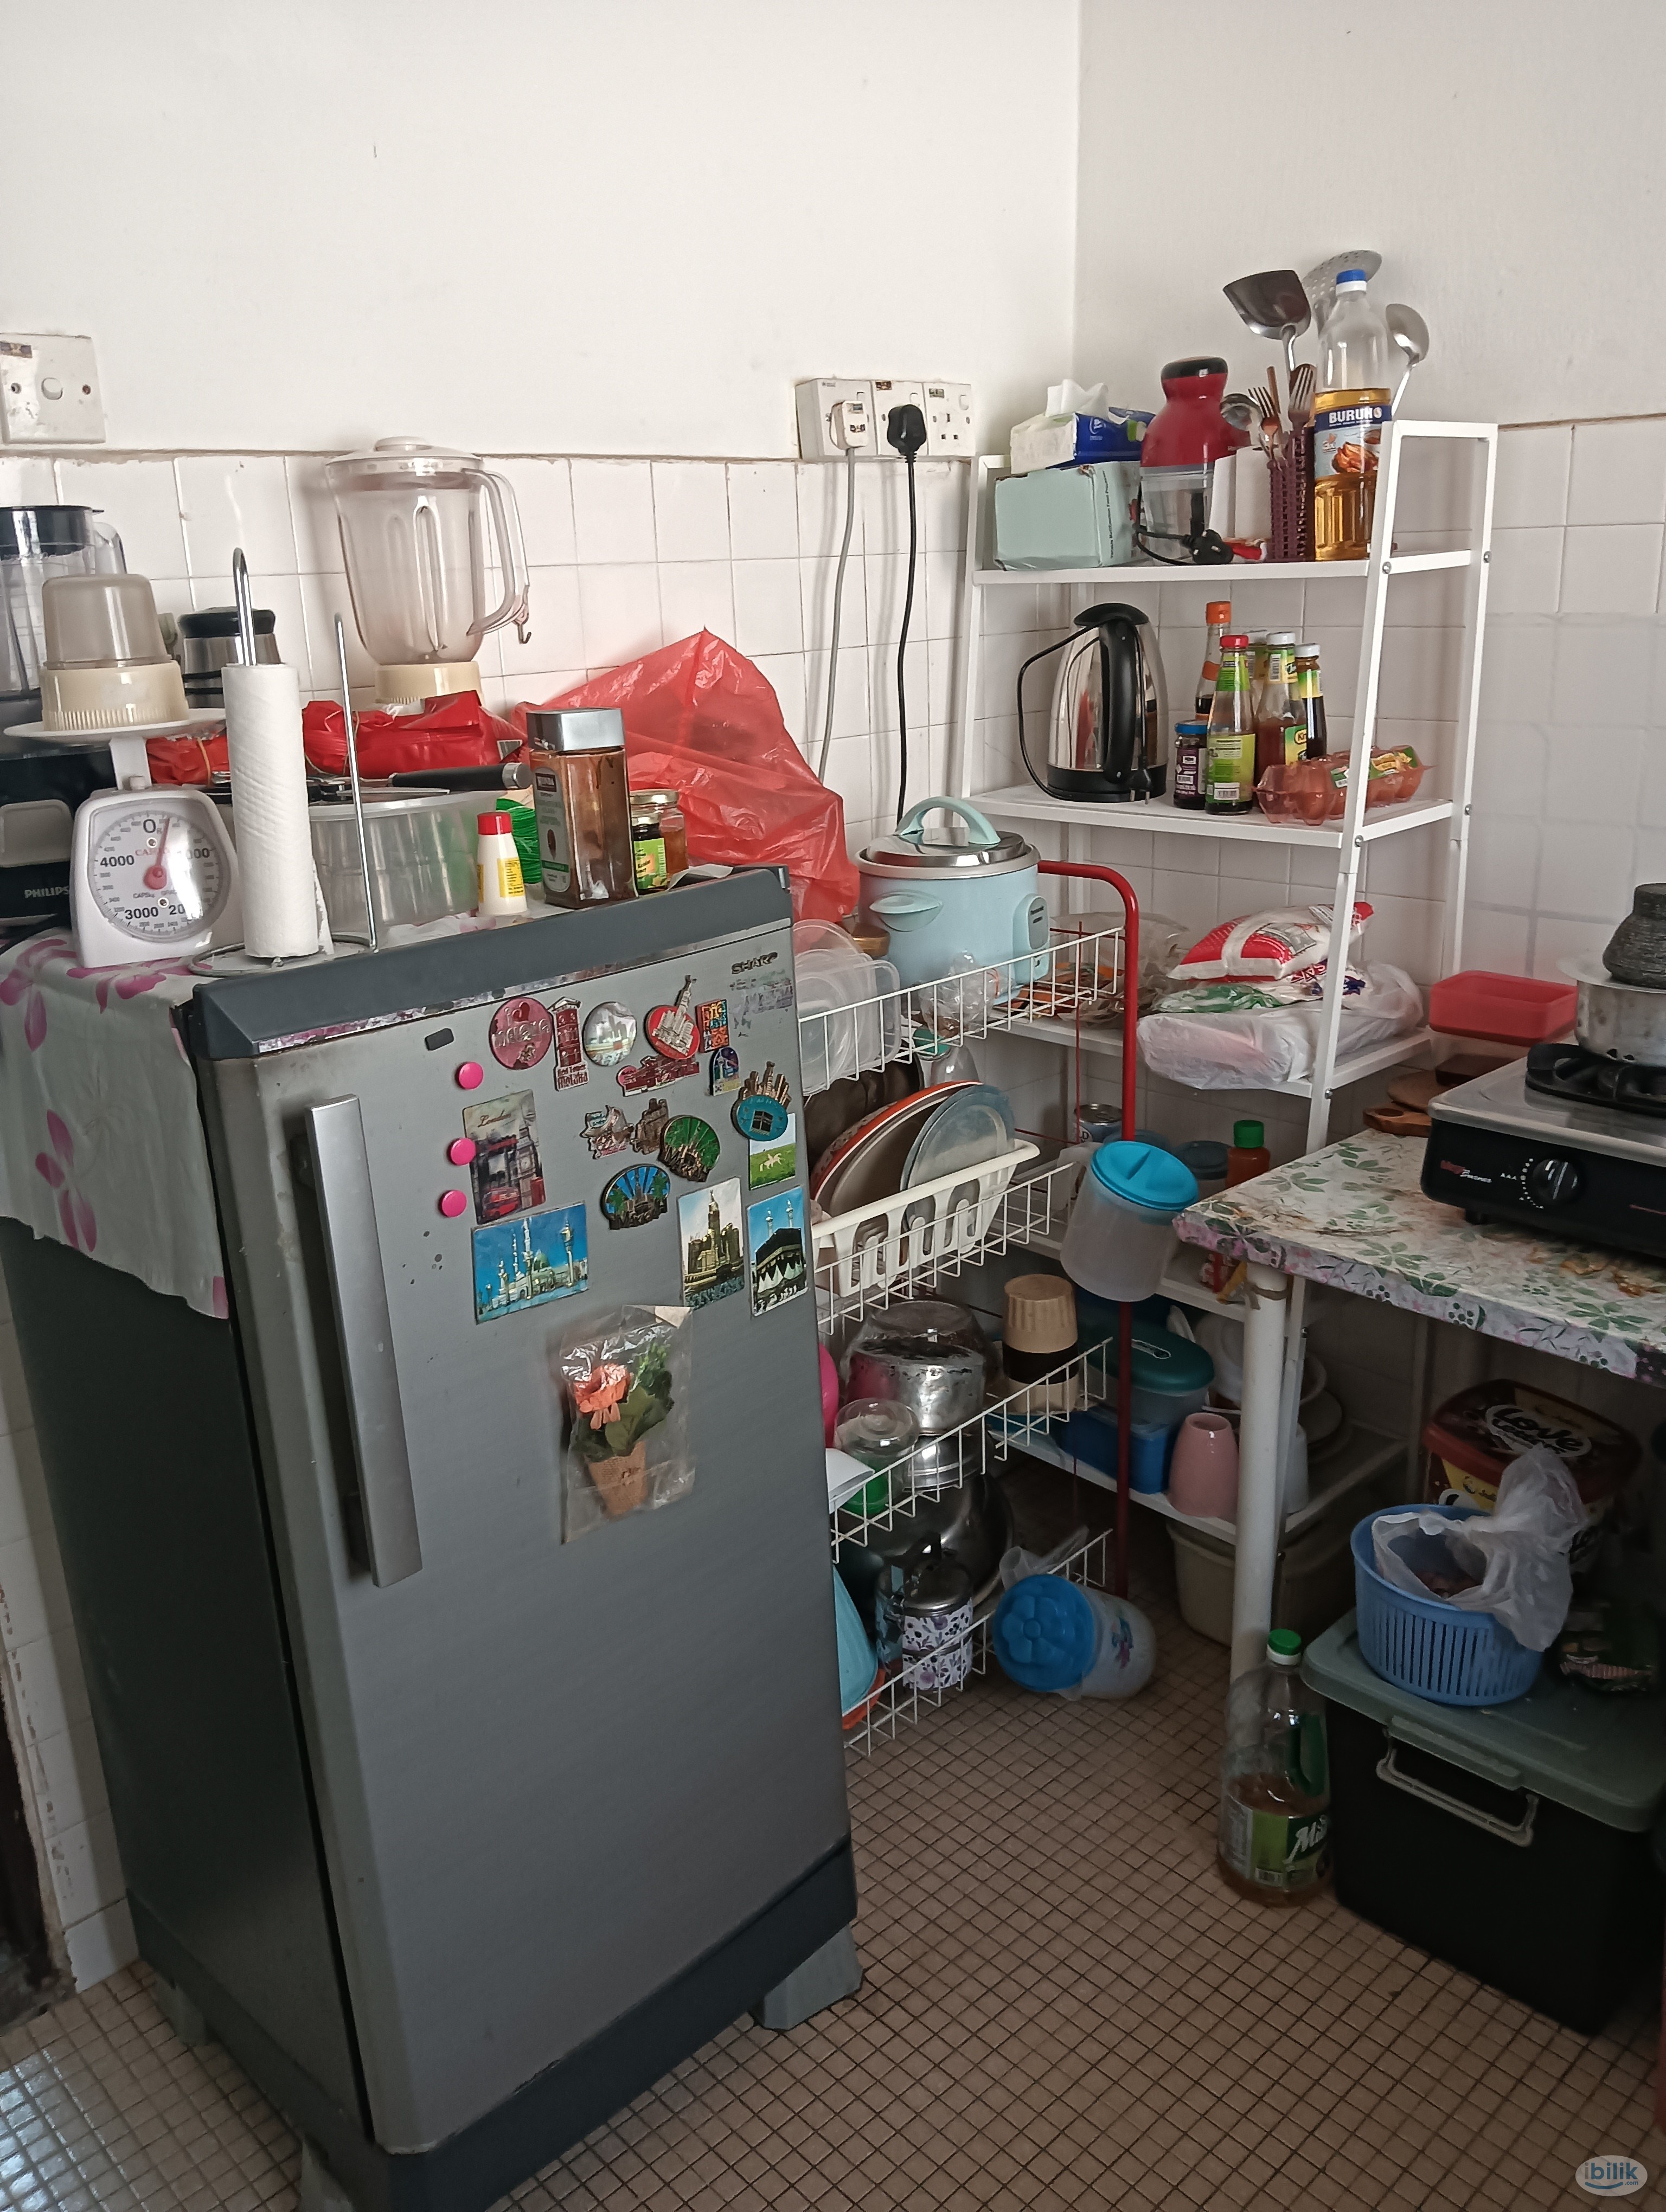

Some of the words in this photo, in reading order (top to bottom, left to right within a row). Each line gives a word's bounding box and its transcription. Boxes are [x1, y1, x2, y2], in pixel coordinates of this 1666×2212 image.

[143, 819, 156, 833] 0
[100, 855, 134, 867] 4000
[24, 886, 69, 898] PHILIPS
[124, 906, 159, 920] 3000
[732, 952, 778, 974] SHARP
[478, 1110, 511, 1127] London
[1492, 1407, 1584, 1452] Love
